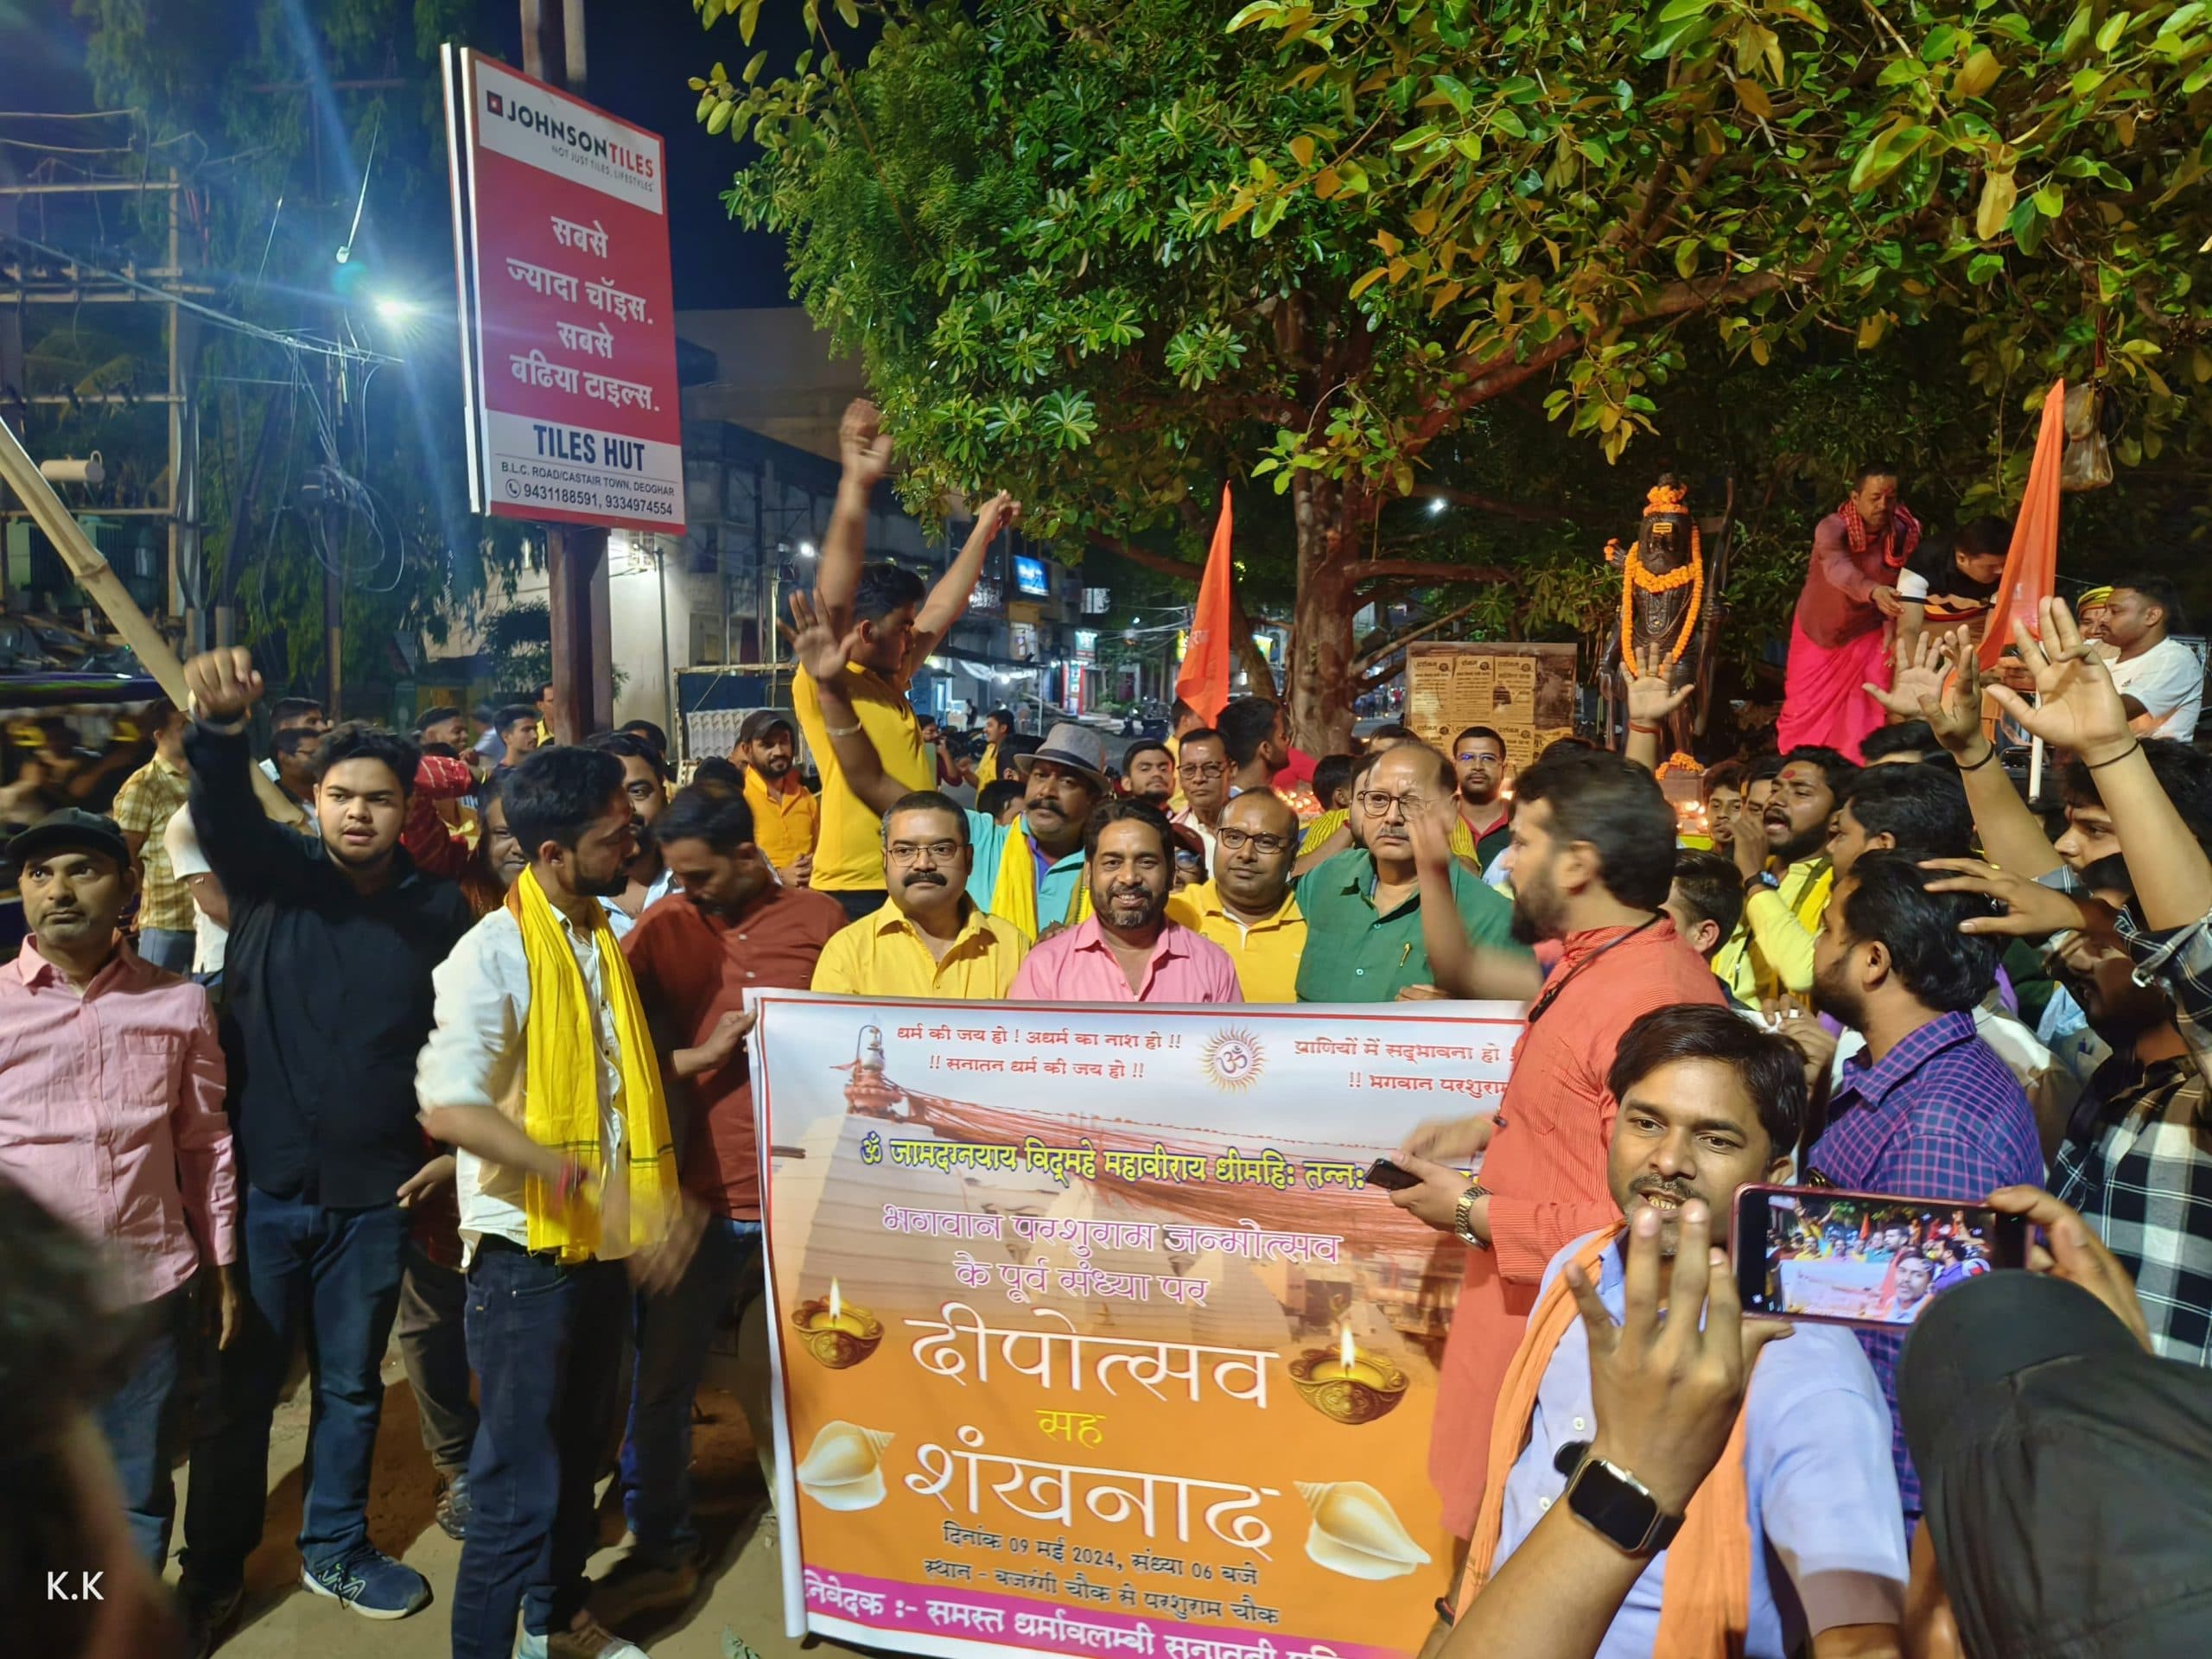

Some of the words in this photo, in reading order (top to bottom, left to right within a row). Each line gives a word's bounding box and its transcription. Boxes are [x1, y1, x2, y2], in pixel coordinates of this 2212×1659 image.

[571, 152, 588, 167] JUST
[614, 169, 653, 193] LIFESTYLES
[550, 216, 608, 259] सबसे
[506, 257, 579, 303] ज्यादा
[556, 321, 614, 359] सबसे
[533, 424, 596, 464] TILES
[604, 437, 645, 472] HUT
[606, 494, 673, 516] 9334974554
[897, 1023, 924, 1039] धर्म
[928, 1025, 951, 1040] की
[957, 1029, 986, 1042] जय
[991, 1026, 1008, 1045] हो
[1027, 1027, 1069, 1045] अधर्म
[1074, 1033, 1099, 1046] का
[1104, 1034, 1140, 1049] नाश
[1144, 1031, 1162, 1050] हो
[1294, 1036, 1358, 1055] प्राणियों
[1363, 1038, 1381, 1056] में
[1385, 1044, 1474, 1065] सद्भावना
[1481, 1043, 1500, 1063] हो
[946, 1057, 1005, 1072] सनातन
[1010, 1057, 1038, 1073] धर्म
[1044, 1057, 1067, 1075] की
[1072, 1063, 1103, 1076] जय
[1109, 1059, 1126, 1079] हो
[1369, 1074, 1433, 1092] भगवान
[1103, 1142, 1207, 1184] महावीराय
[882, 1204, 1005, 1240] भगवान
[1009, 1215, 1160, 1259] परशुराम
[1163, 1217, 1344, 1265] जन्मोत्सव
[953, 1249, 994, 1289] के
[995, 1255, 1050, 1304] पूर्व
[1055, 1261, 1153, 1301] संध्या
[1156, 1274, 1211, 1307] पर
[903, 1300, 1281, 1410] दीपोत्सव
[1034, 1408, 1107, 1450] सह
[903, 1423, 1282, 1562] शंखनाद
[943, 1520, 1003, 1549] दिनांक
[1008, 1537, 1029, 1553] 09
[1035, 1535, 1065, 1563] मई
[1071, 1546, 1123, 1572] 2024,
[1130, 1548, 1184, 1576] संध्या
[1191, 1561, 1213, 1580] 06
[1221, 1560, 1260, 1586] बजे
[923, 1559, 972, 1581] स्थान
[995, 1568, 1058, 1594] बजरंगी
[1064, 1571, 1111, 1603] चौक
[1118, 1582, 1136, 1606] से
[1143, 1591, 1224, 1620] परशुराम
[1230, 1593, 1280, 1625] चौक
[925, 1599, 1006, 1634] समस्त
[1014, 1609, 1156, 1656] धर्मावलम्बी
